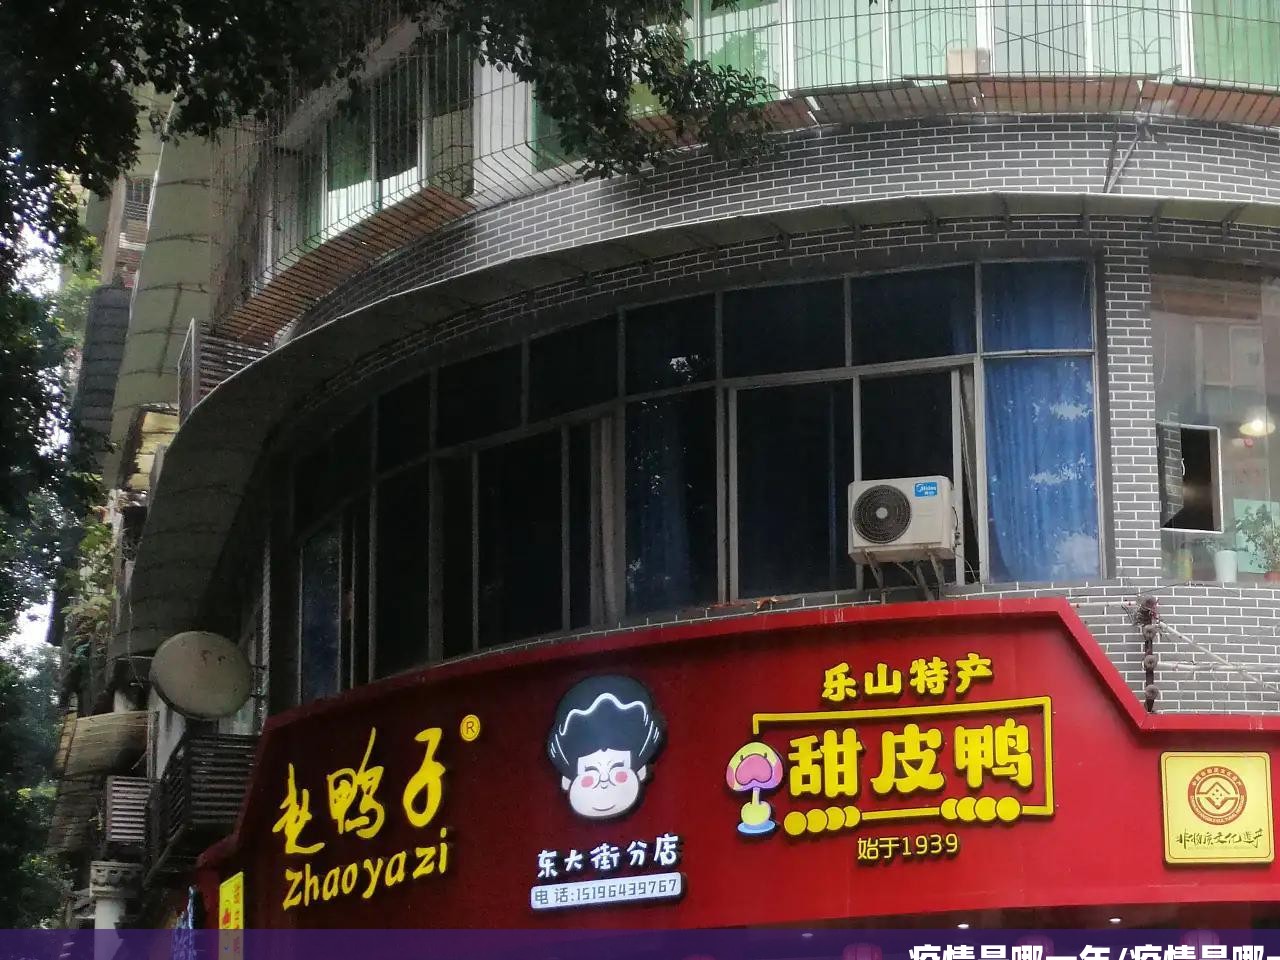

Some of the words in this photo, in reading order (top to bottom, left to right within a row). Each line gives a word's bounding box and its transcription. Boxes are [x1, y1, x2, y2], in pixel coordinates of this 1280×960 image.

[822, 653, 993, 701] 乐山特产
[788, 718, 1033, 797] 甜皮鸭
[537, 833, 679, 878] 东大街分店
[857, 833, 959, 861] 始于1939
